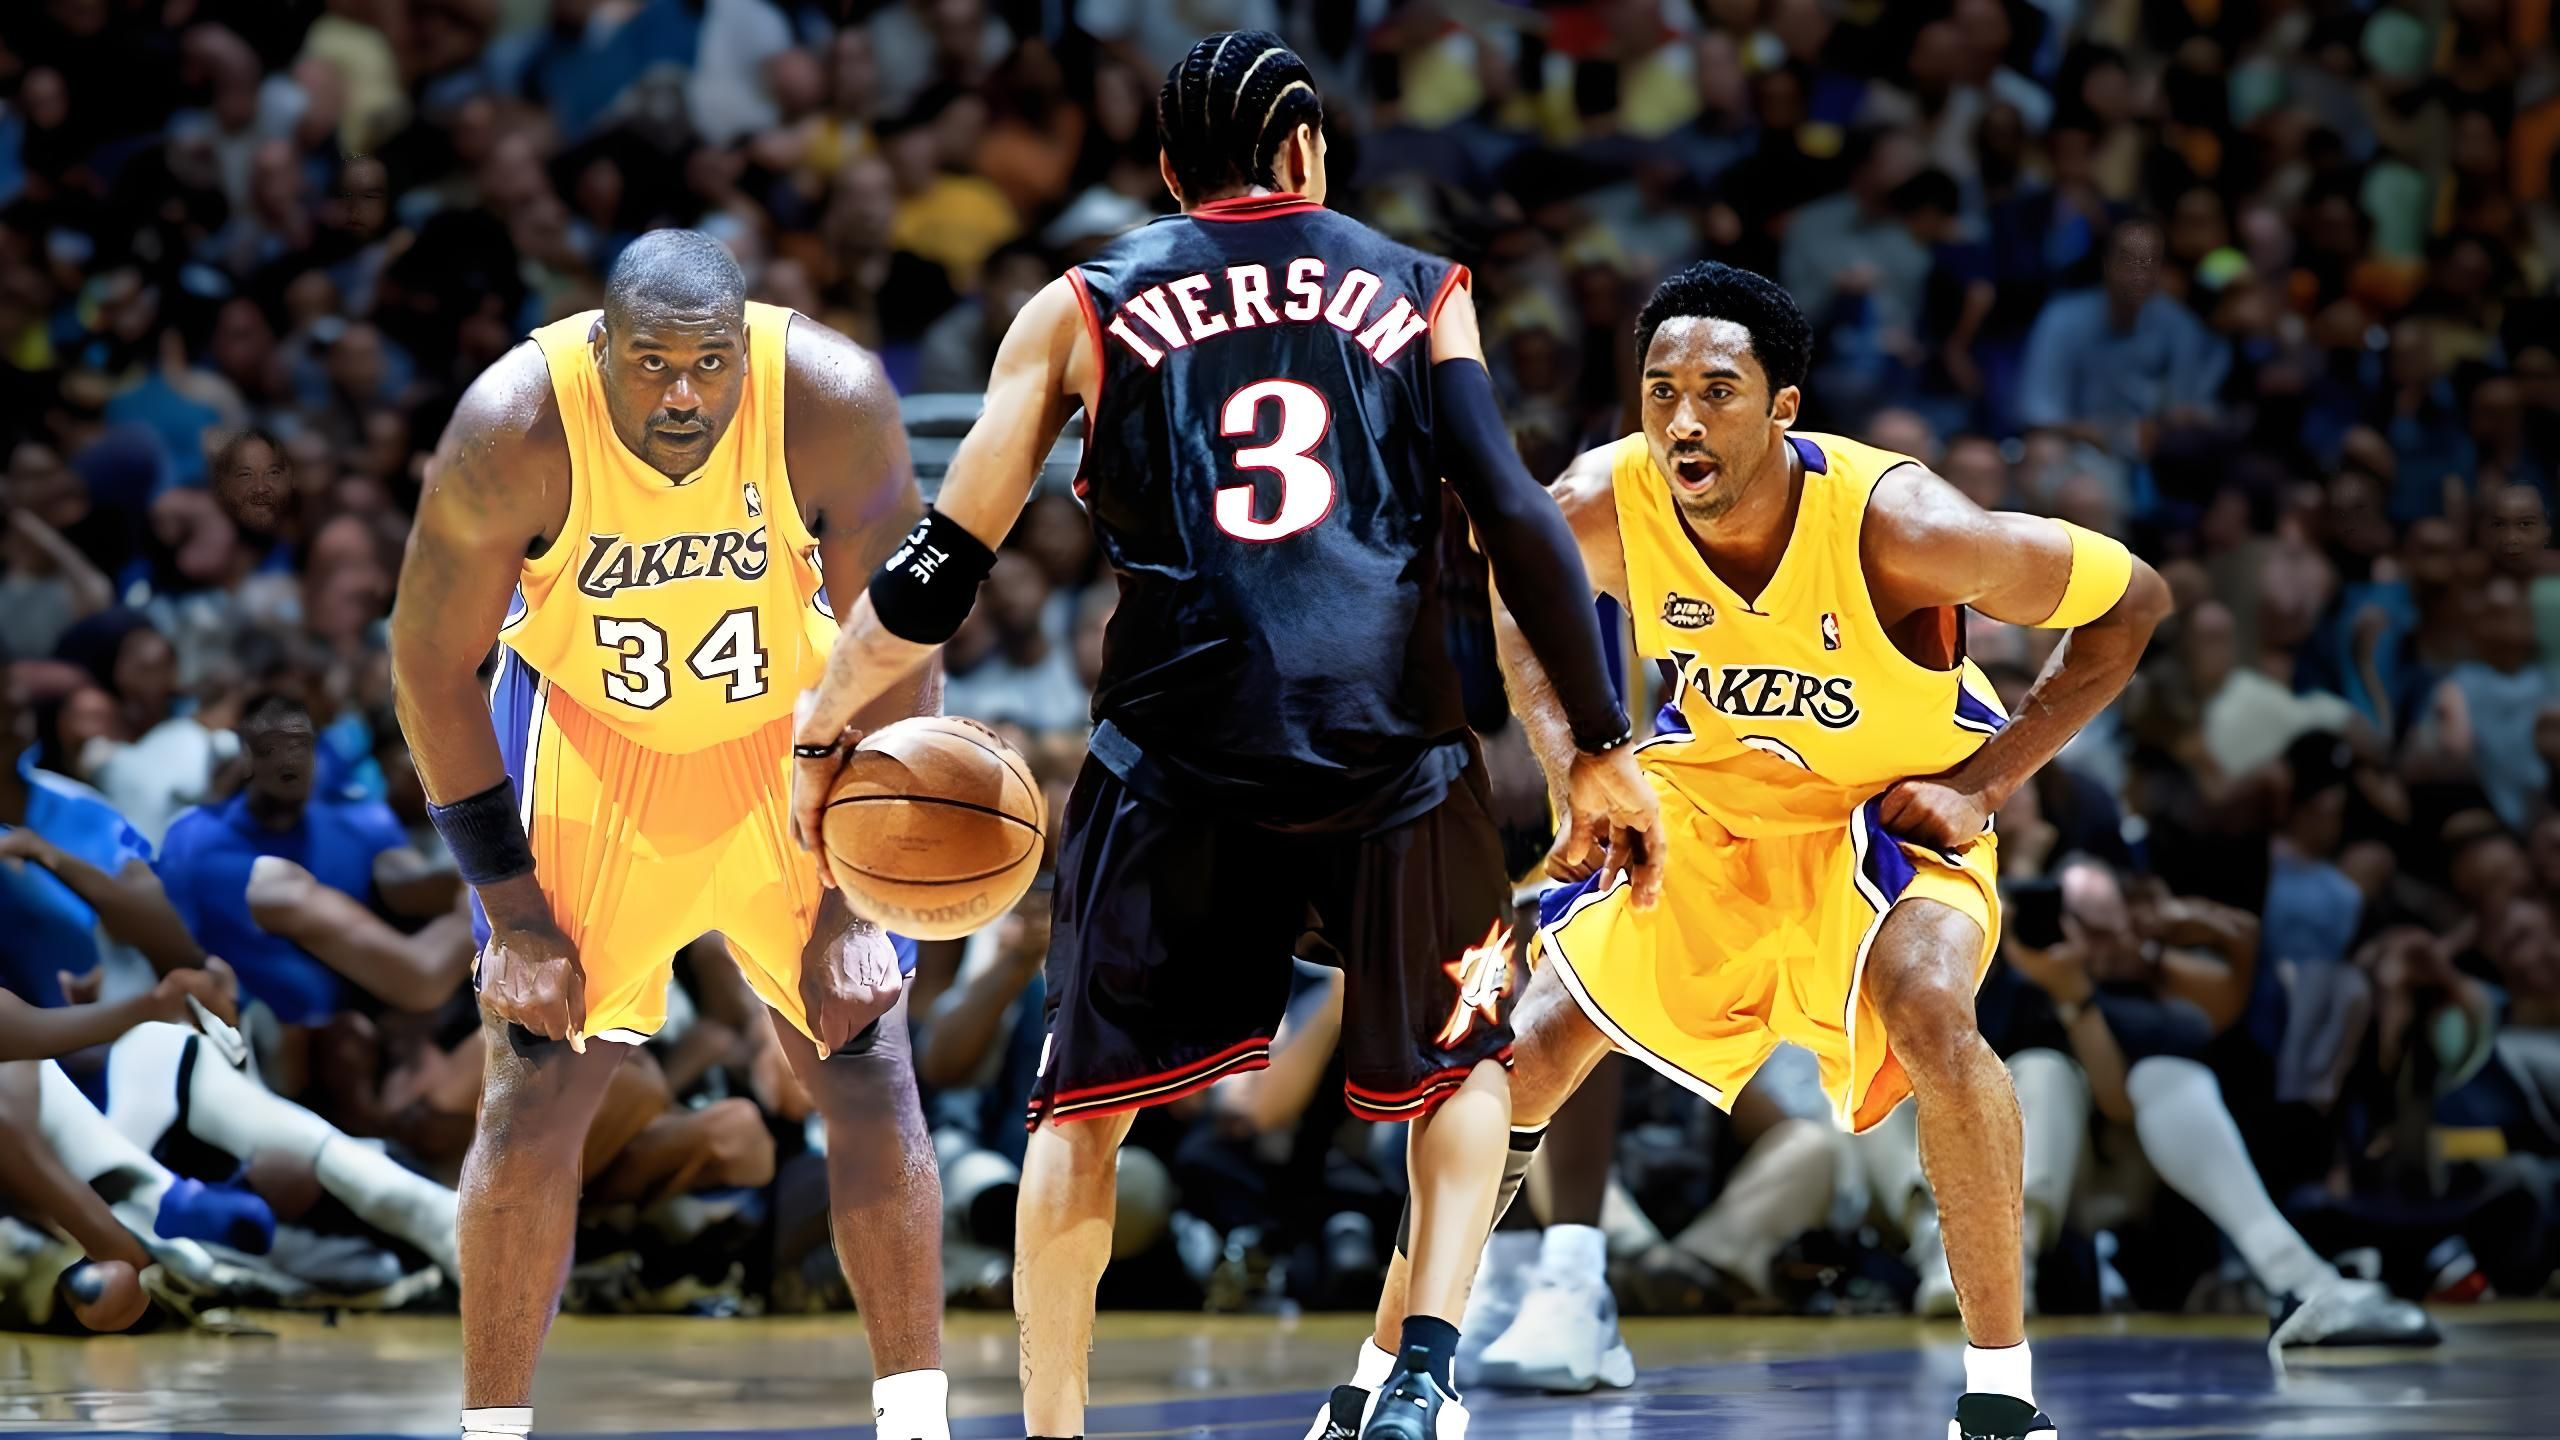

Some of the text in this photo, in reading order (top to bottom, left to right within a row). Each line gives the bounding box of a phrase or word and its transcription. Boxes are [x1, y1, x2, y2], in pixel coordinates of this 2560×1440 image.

[1107, 256, 1430, 370] IVERSON
[1213, 377, 1337, 544] 3
[577, 524, 769, 599] LAKERS
[908, 545, 950, 585] THE
[592, 605, 769, 711] 34
[851, 885, 990, 924] DING
